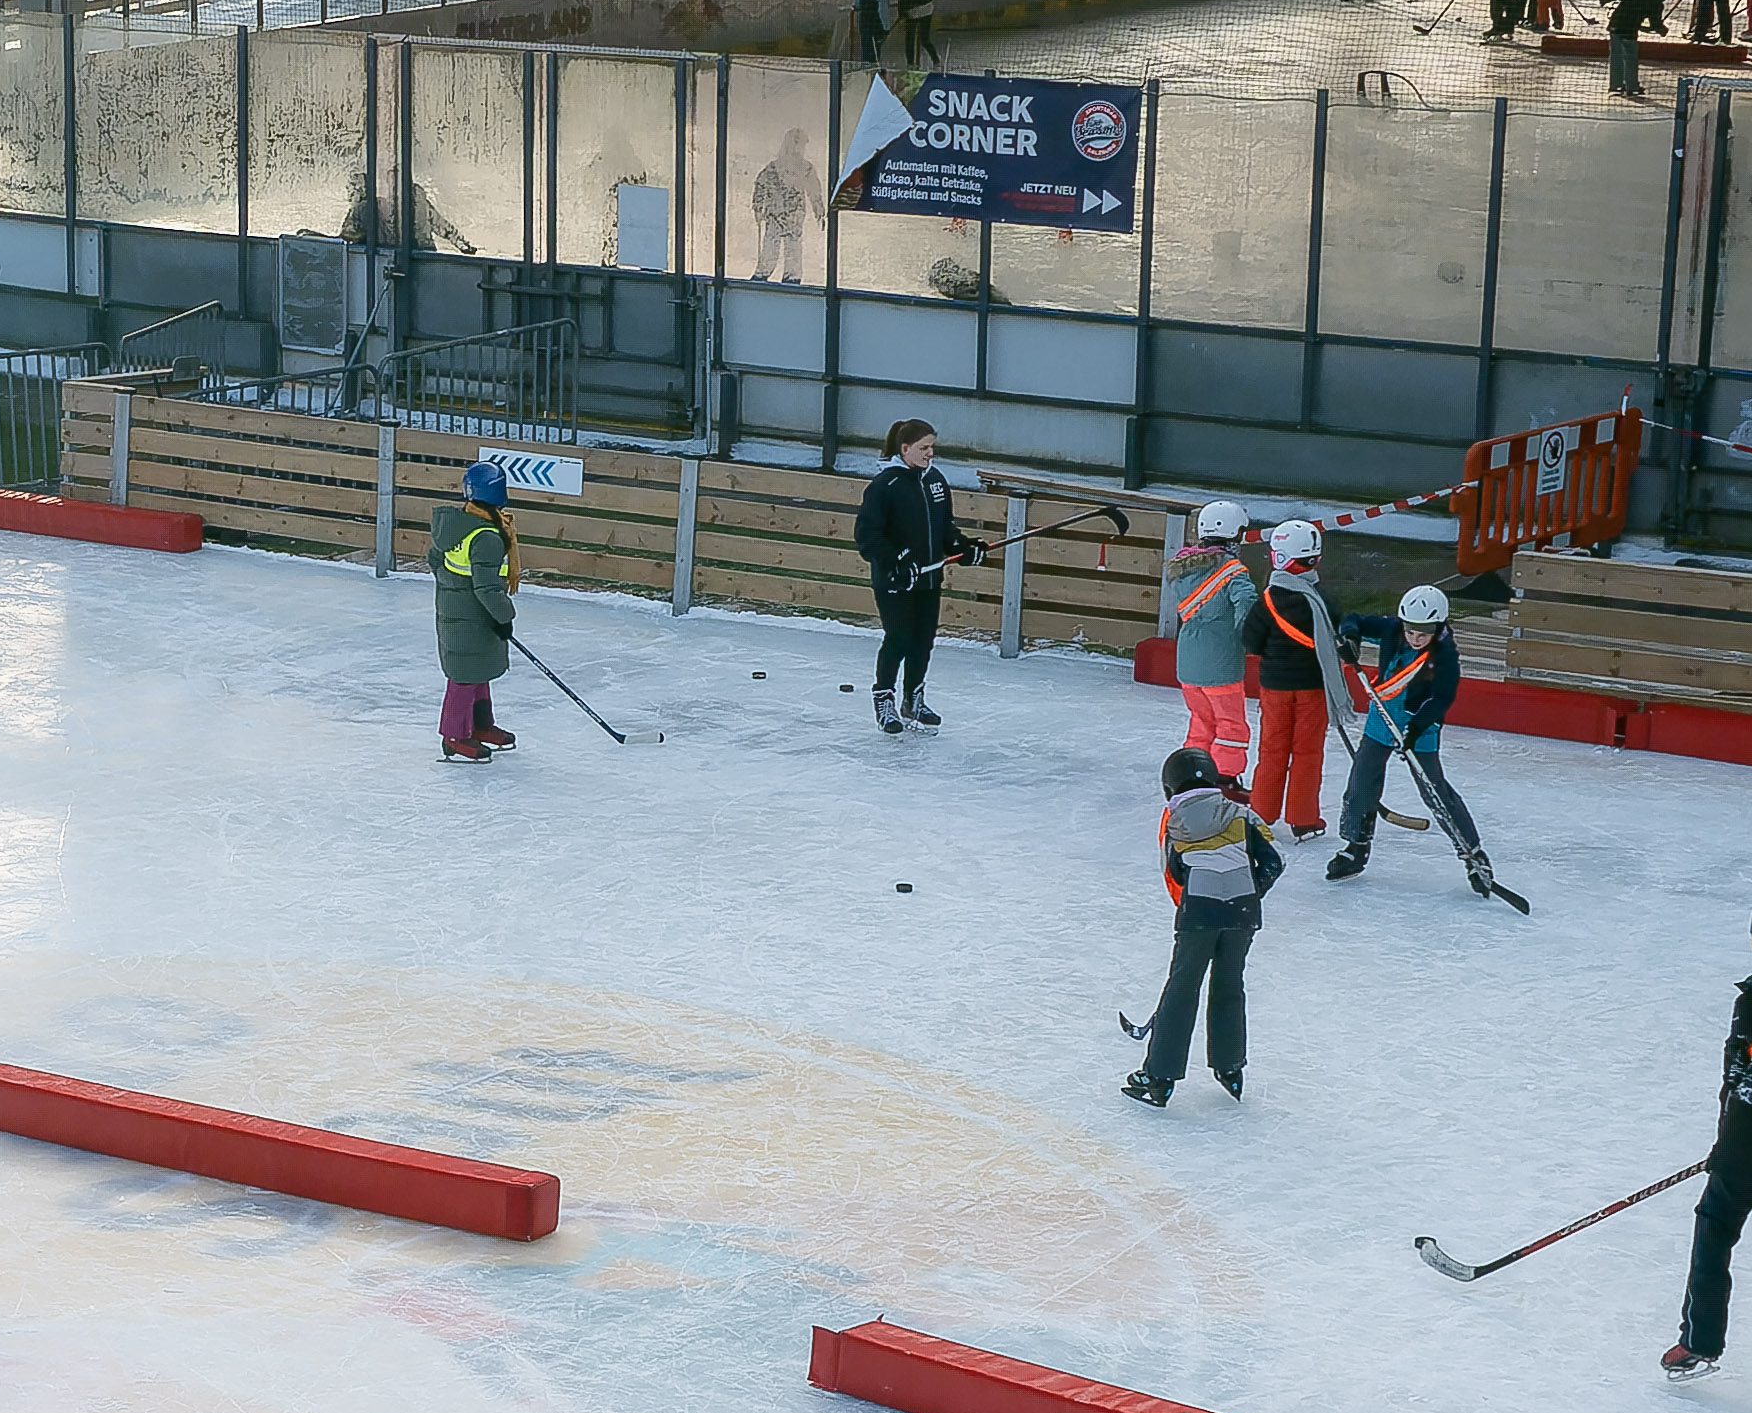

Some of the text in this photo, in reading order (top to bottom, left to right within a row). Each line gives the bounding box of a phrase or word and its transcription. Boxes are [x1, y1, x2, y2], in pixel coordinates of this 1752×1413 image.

[928, 89, 1034, 123] SNACK
[908, 120, 1037, 157] CORNER
[884, 159, 989, 180] Automaten mit Kaffee,
[878, 173, 984, 194] Kakao, kalte Getränke,
[1020, 182, 1077, 196] JETZT NEU
[871, 185, 982, 206] Süßigkeiten und Snacks
